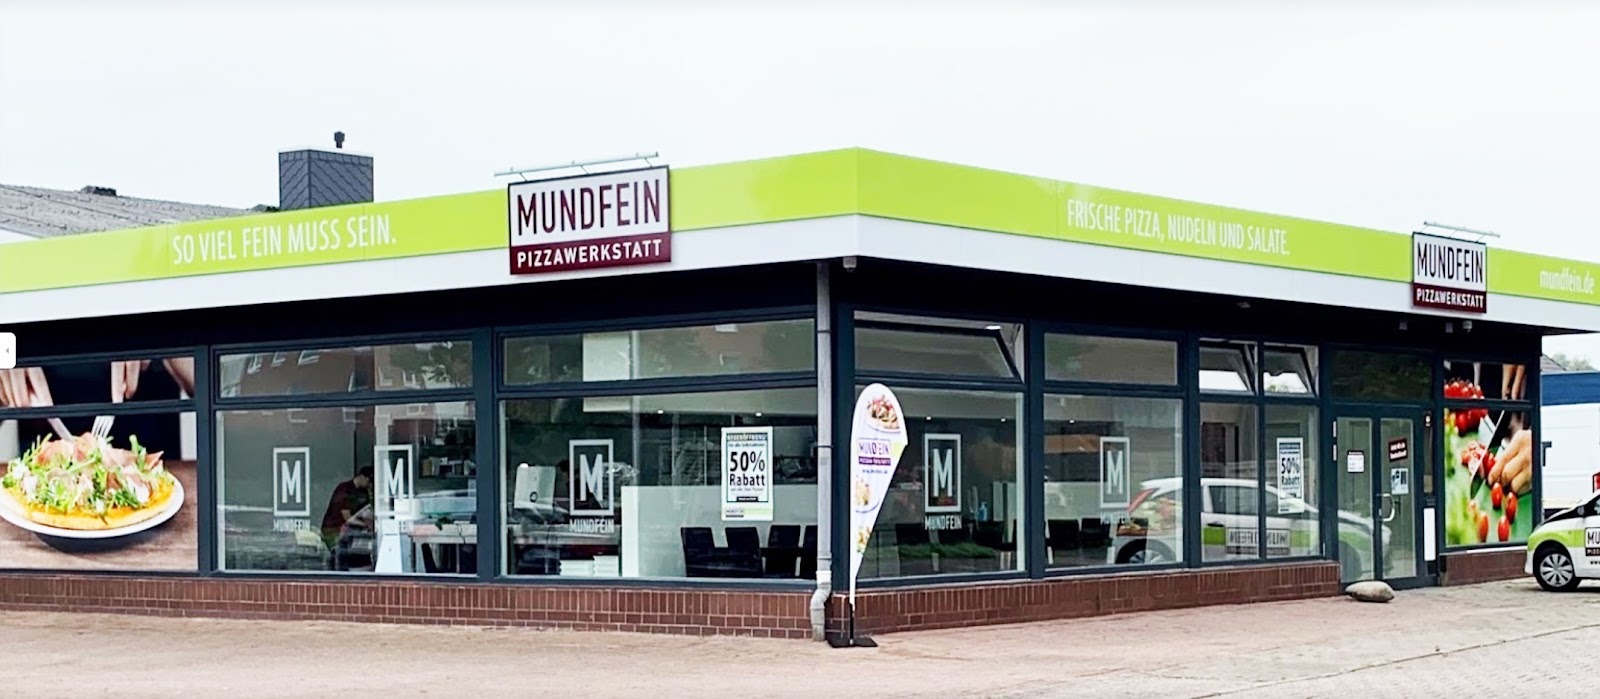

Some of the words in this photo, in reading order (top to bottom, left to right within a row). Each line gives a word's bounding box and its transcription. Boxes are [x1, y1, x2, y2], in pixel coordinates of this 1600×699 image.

[517, 179, 660, 236] MUNDFEIN
[172, 234, 195, 265] SO
[198, 230, 237, 263] VIEL
[242, 223, 282, 258] FEIN
[287, 219, 341, 254] MUSS
[346, 214, 396, 249] SEIN.
[1067, 199, 1121, 233] FRISCHE
[1124, 207, 1164, 243] PIZZA,
[1168, 214, 1216, 246] NUDELN
[1219, 222, 1244, 250] UND
[1247, 225, 1291, 255] SALATE.
[517, 239, 662, 268] PIZZAWERKSTATT
[1417, 242, 1483, 284] MUNDFEIN
[1540, 267, 1595, 295] mundfein.de
[1416, 287, 1484, 309] PIZZAWERKSTATT
[730, 451, 765, 472] 50%
[859, 442, 889, 455] MUNDEIN
[383, 458, 404, 503] M
[580, 454, 603, 501] M
[729, 473, 765, 486] Rabatt
[933, 449, 952, 497] M
[1107, 450, 1123, 494] M
[1281, 457, 1300, 475] 50%
[281, 460, 301, 503] M
[1281, 476, 1300, 486] Rabatt
[569, 519, 614, 533] MUNDFEIN
[924, 515, 962, 530] MUNDFEIN
